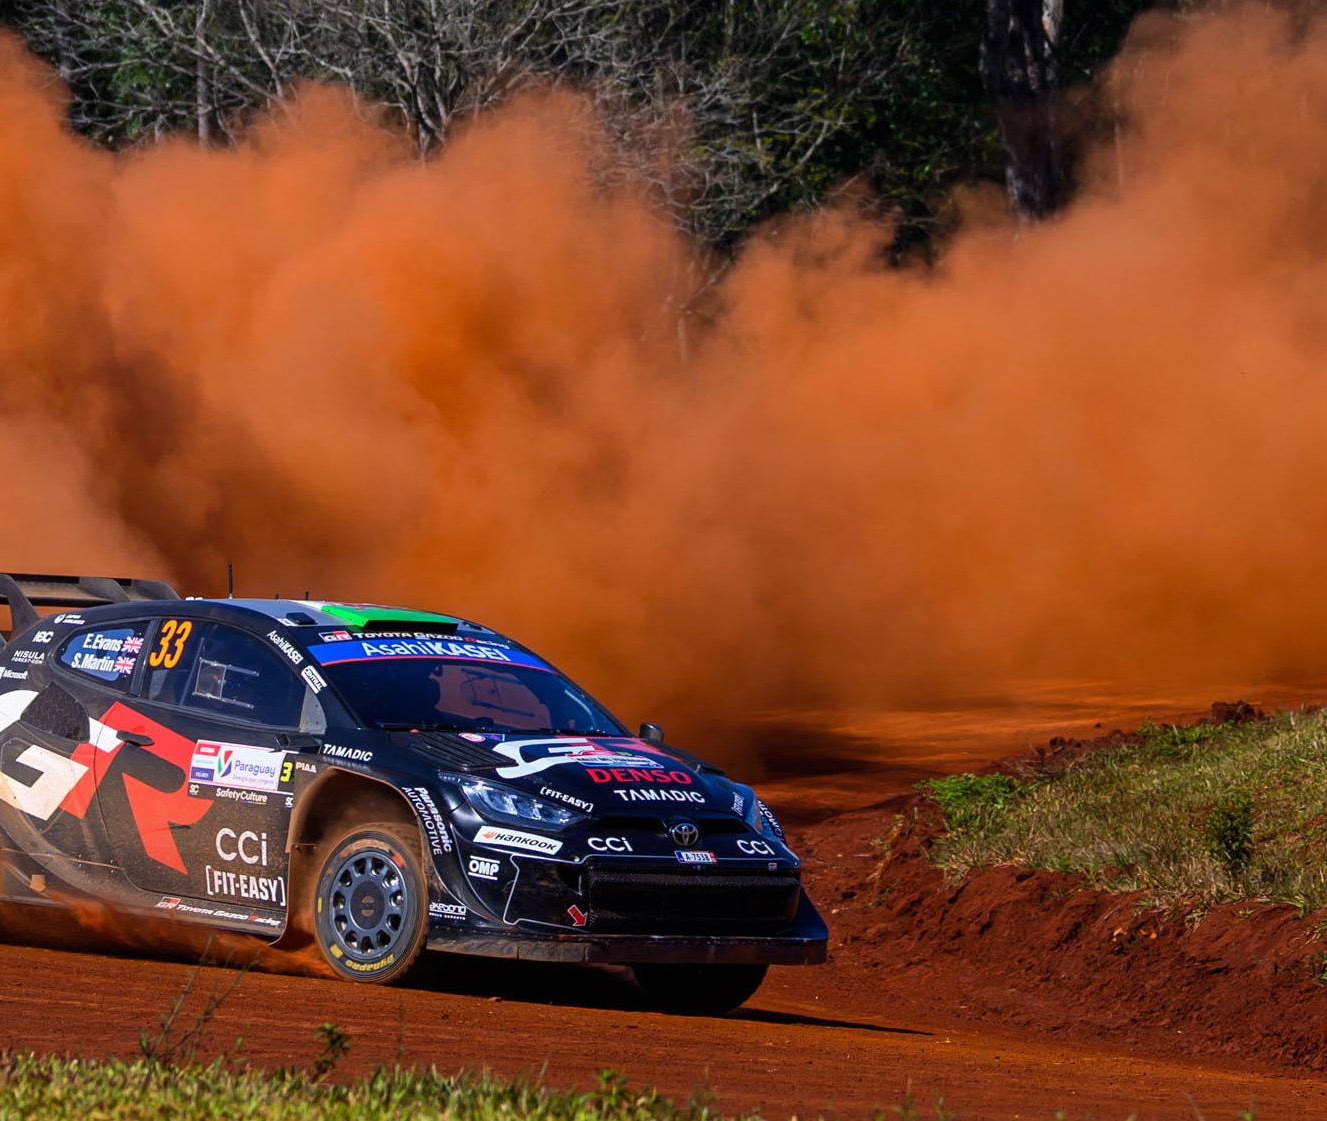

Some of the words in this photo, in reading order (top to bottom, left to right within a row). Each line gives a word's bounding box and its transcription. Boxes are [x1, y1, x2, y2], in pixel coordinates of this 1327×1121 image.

[82, 633, 123, 652] E.Evans
[149, 619, 193, 669] 33
[321, 632, 352, 642] GR
[13, 650, 45, 660] NISULA
[266, 630, 304, 664] AsahiKASEI
[361, 641, 512, 662] AsahiKASEI
[70, 652, 115, 672] S.Martin
[2, 668, 28, 680] Microsoft
[322, 743, 373, 762] TAMADIC
[234, 760, 276, 778] Paraguay
[295, 761, 317, 773] PIAA
[585, 768, 693, 785] DENSO
[215, 787, 268, 802] SafetyCulture
[613, 789, 706, 803] TAMADIC
[401, 786, 443, 856] AUTOMOTIVE
[413, 787, 453, 853] Panasonic
[469, 859, 500, 876] OMP
[177, 904, 214, 915] TOYOTA
